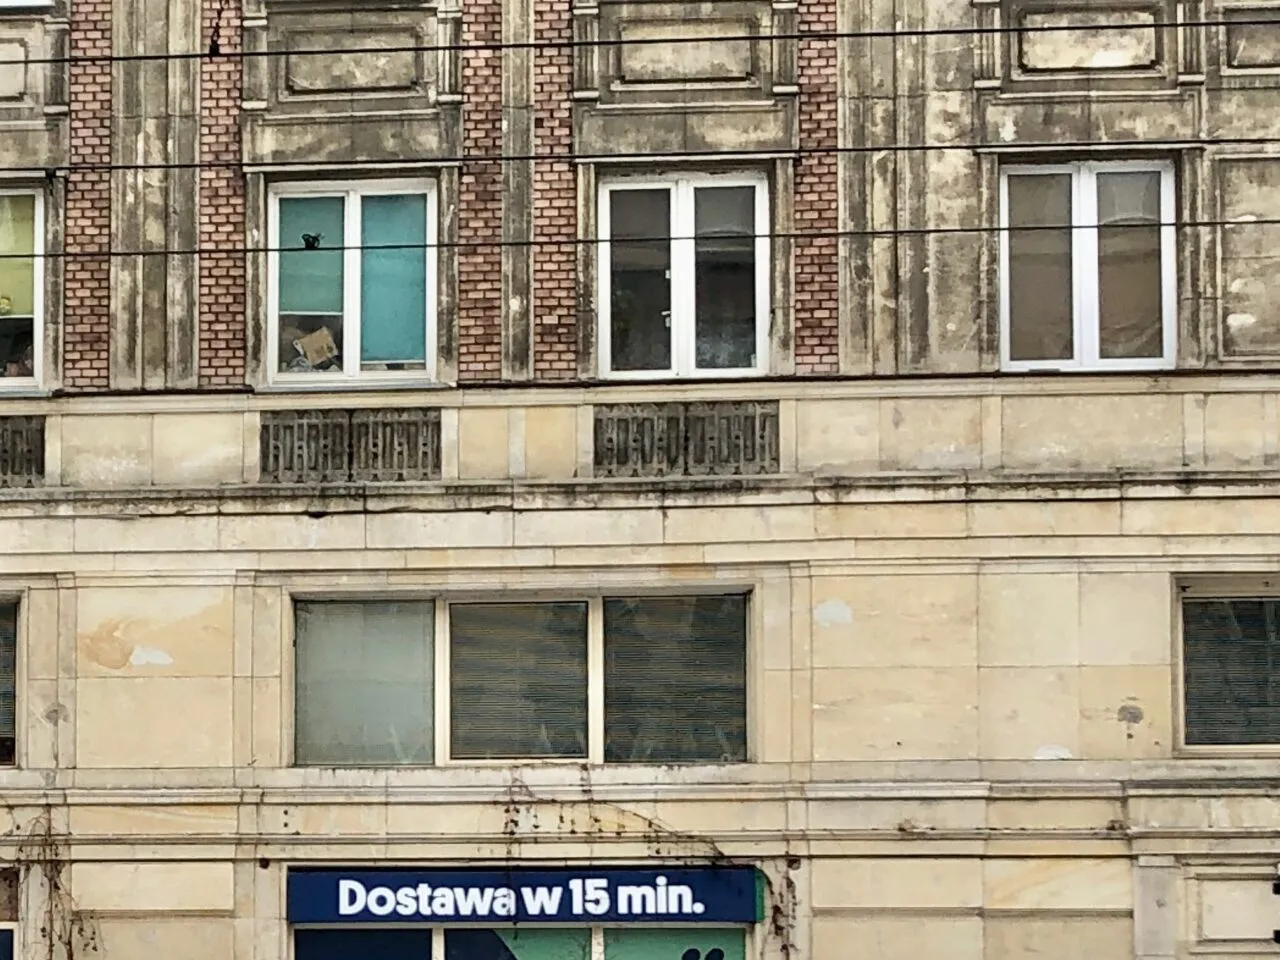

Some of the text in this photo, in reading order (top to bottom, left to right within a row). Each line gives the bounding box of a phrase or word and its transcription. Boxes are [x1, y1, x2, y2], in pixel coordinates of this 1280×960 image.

[338, 875, 706, 916] Dostawa w 15 min.
